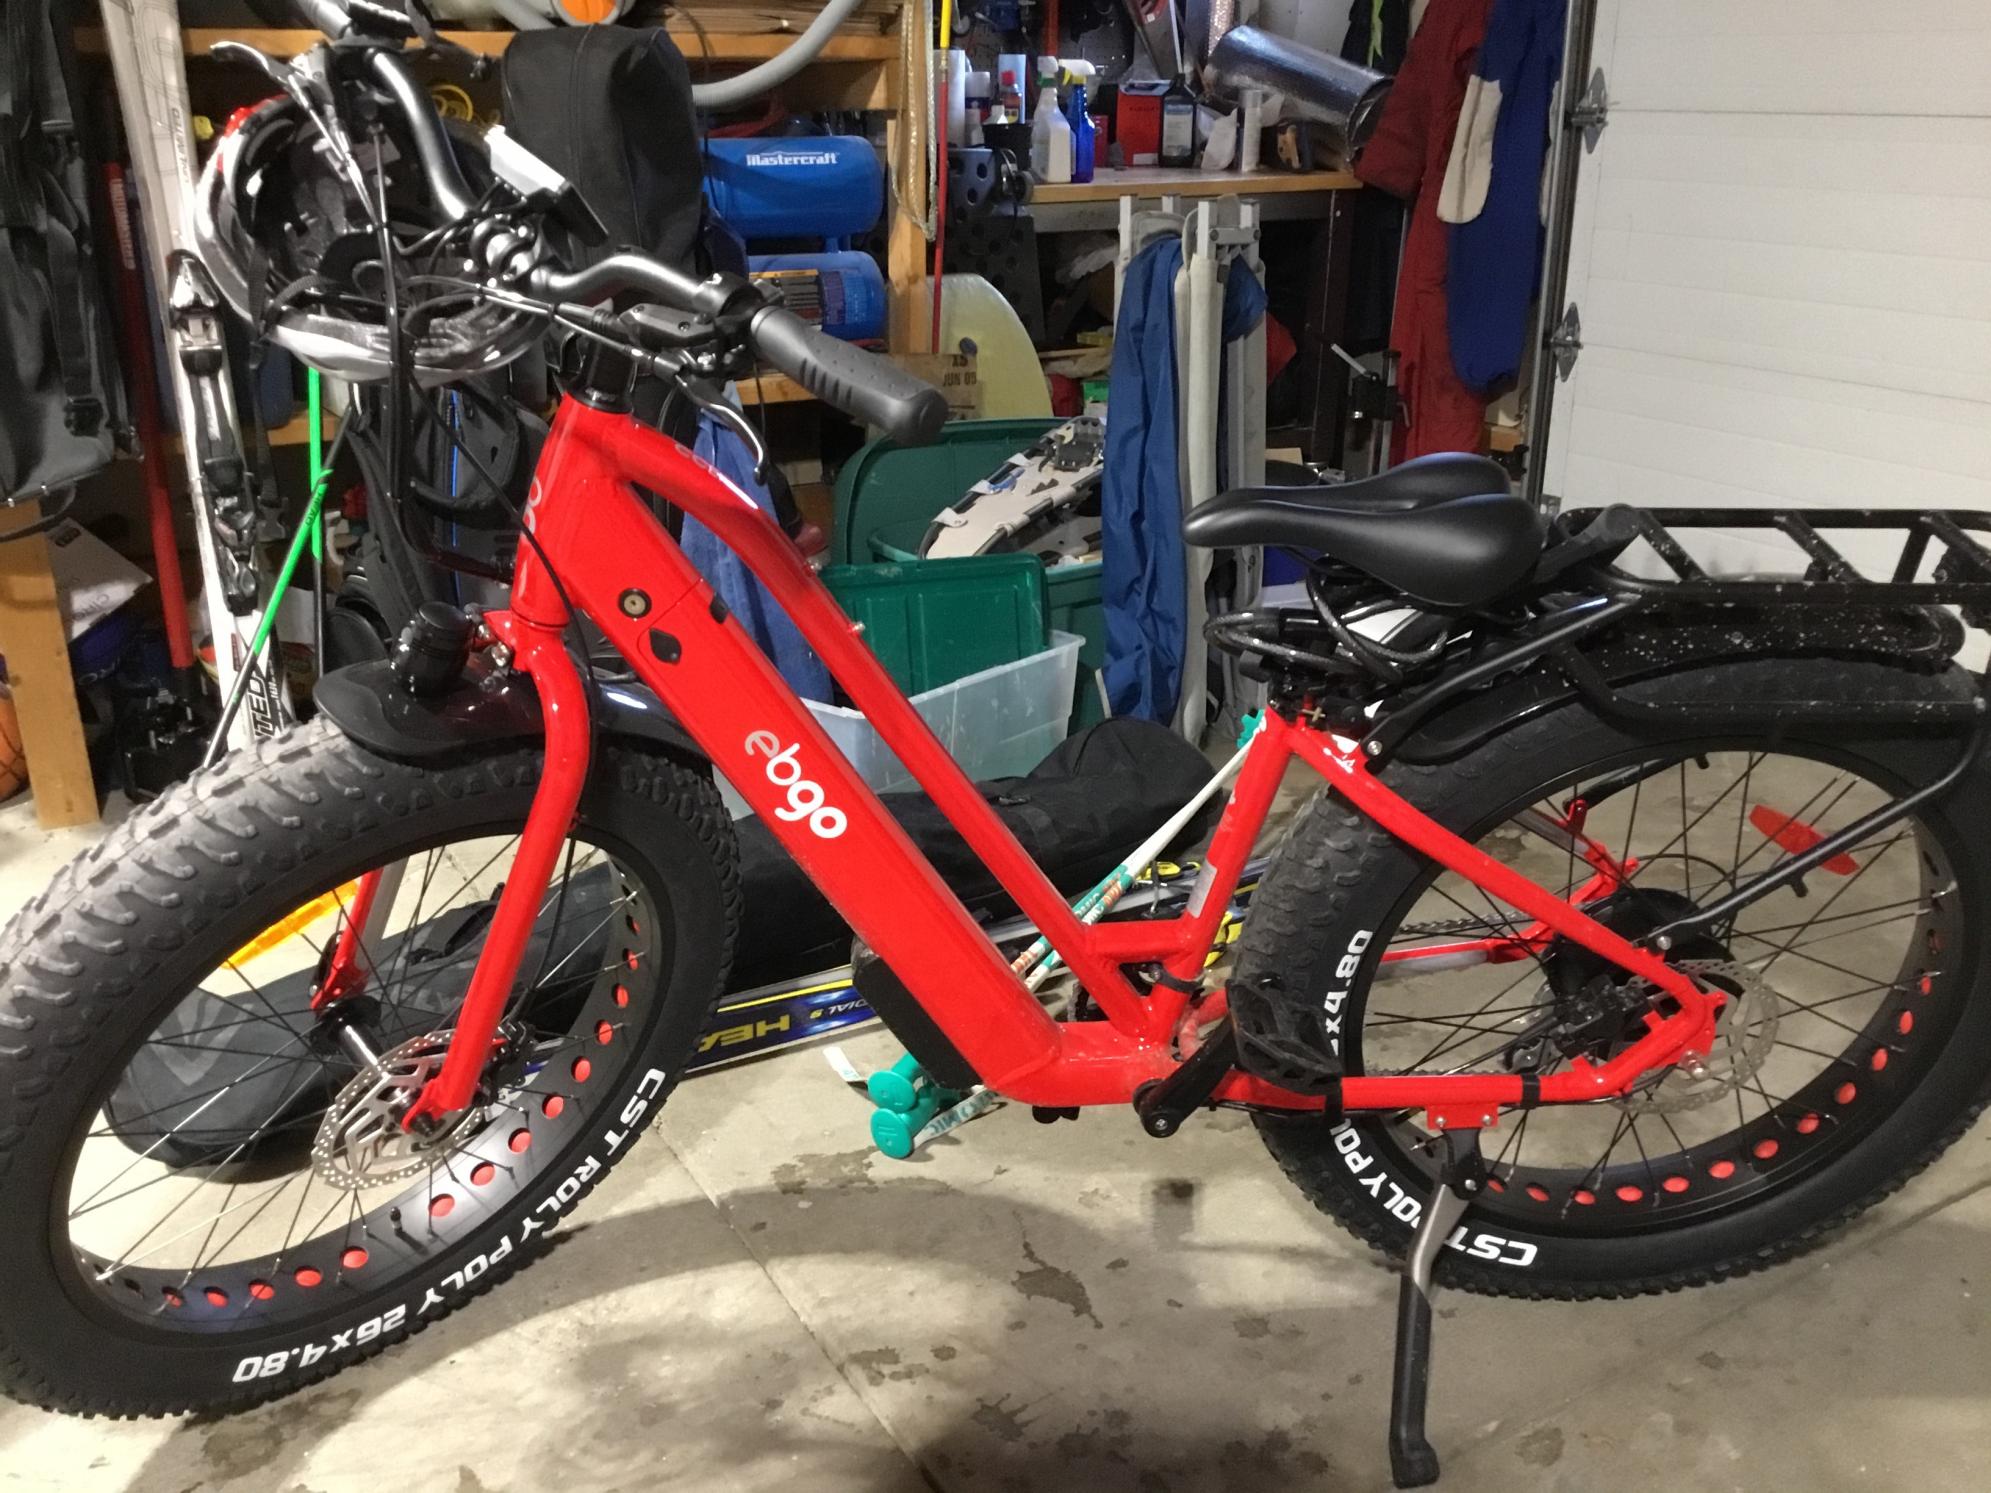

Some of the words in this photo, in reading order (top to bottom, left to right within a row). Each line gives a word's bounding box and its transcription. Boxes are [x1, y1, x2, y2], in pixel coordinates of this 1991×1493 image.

[745, 152, 838, 167] Mastercraft
[744, 729, 848, 839] ebgo
[1323, 929, 1374, 1057] x4.80
[697, 1013, 791, 1054] HEA
[604, 1068, 666, 1157] CST
[1329, 1117, 1375, 1175] POL
[520, 1154, 602, 1244] ROLY
[1358, 1171, 1423, 1230] OLY
[416, 1234, 513, 1316] POLY
[1444, 1225, 1538, 1267] CST
[232, 1303, 407, 1383] 26x4.80
